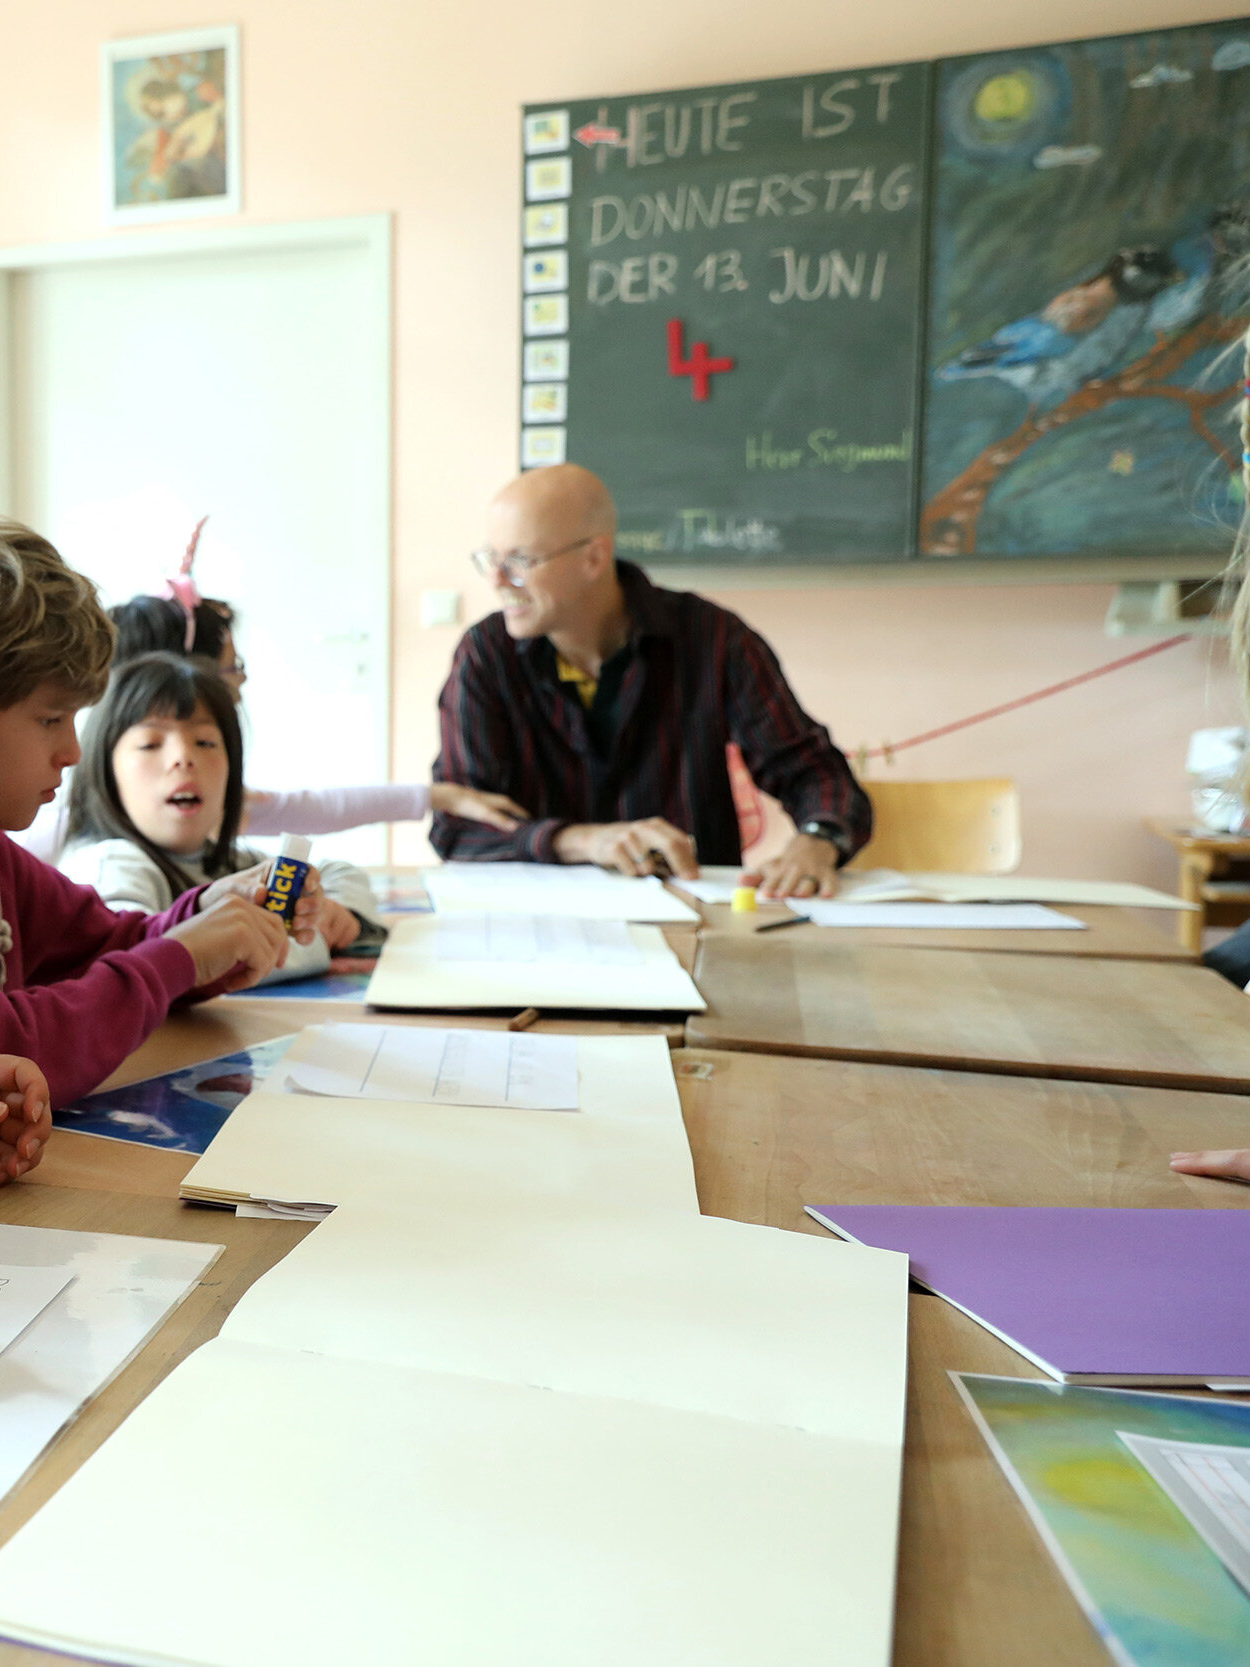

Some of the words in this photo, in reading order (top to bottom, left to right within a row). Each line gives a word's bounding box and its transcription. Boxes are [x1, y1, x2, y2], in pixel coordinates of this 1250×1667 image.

[595, 91, 758, 173] HEUTE
[802, 73, 902, 140] IST
[591, 163, 916, 247] DONNERSTAG
[587, 252, 679, 304] DER
[693, 249, 749, 293] 13.
[769, 246, 888, 304] JUNI
[666, 318, 734, 401] 4
